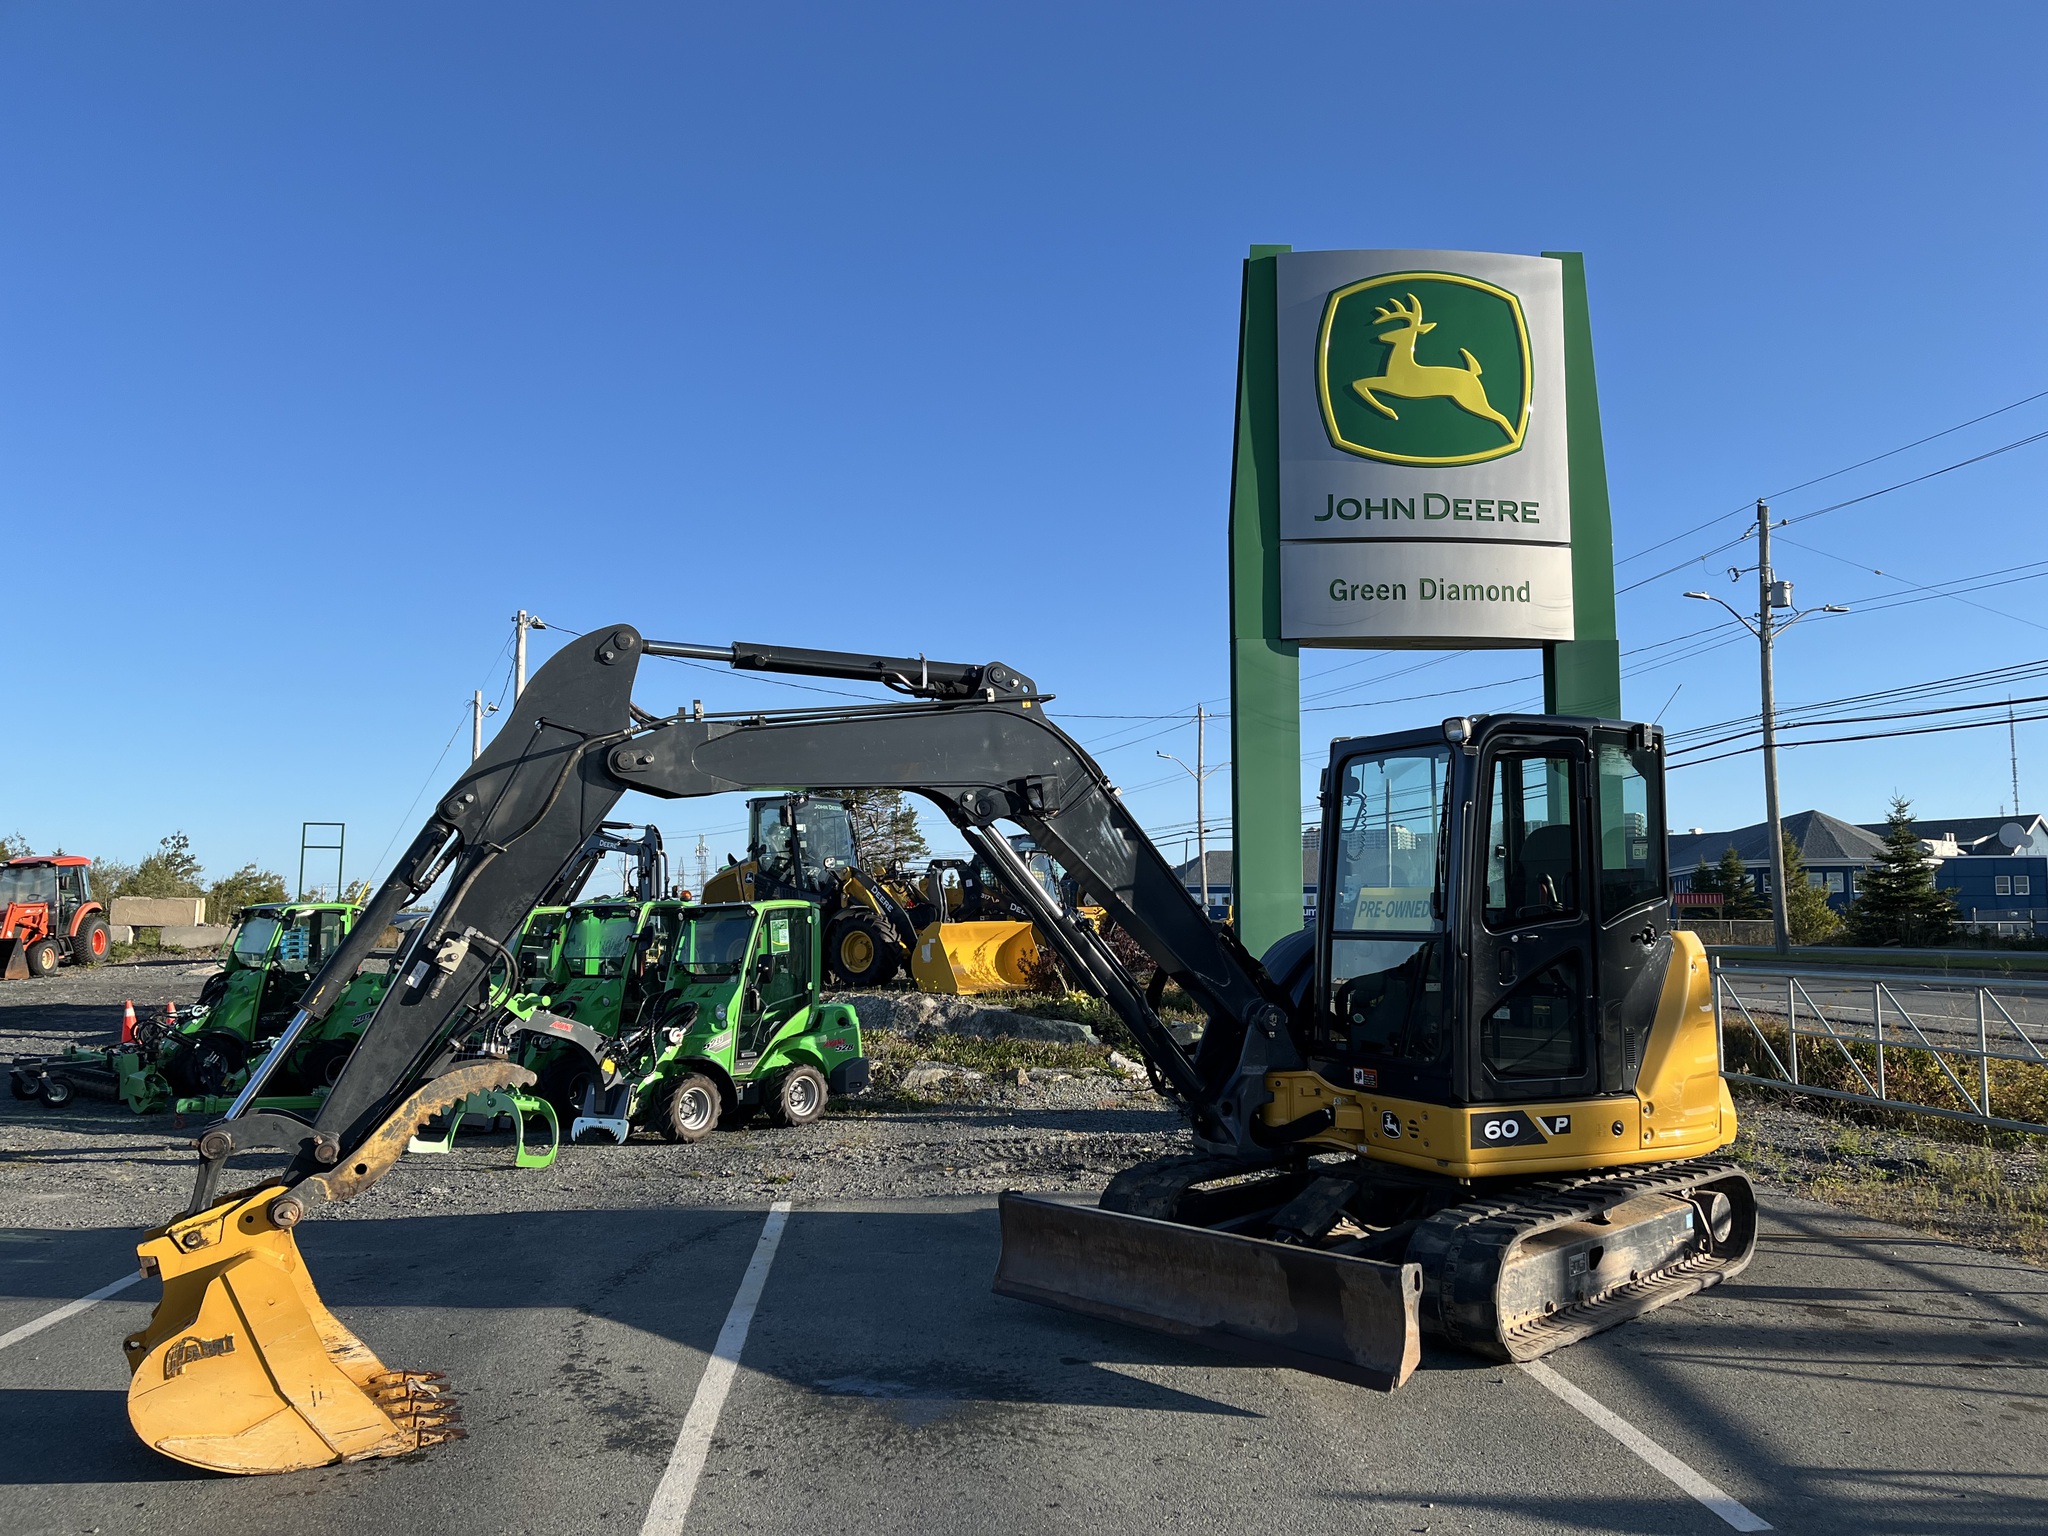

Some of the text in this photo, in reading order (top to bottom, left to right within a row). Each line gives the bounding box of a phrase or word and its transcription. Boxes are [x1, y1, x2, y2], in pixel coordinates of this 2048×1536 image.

[1314, 492, 1540, 524] JOHN DEERE
[1329, 577, 1531, 603] Green Diamond
[870, 884, 894, 913] DEERE
[1358, 900, 1430, 919] PRE-OWNED
[835, 1043, 855, 1053] 528
[1484, 1117, 1569, 1140] 60 P
